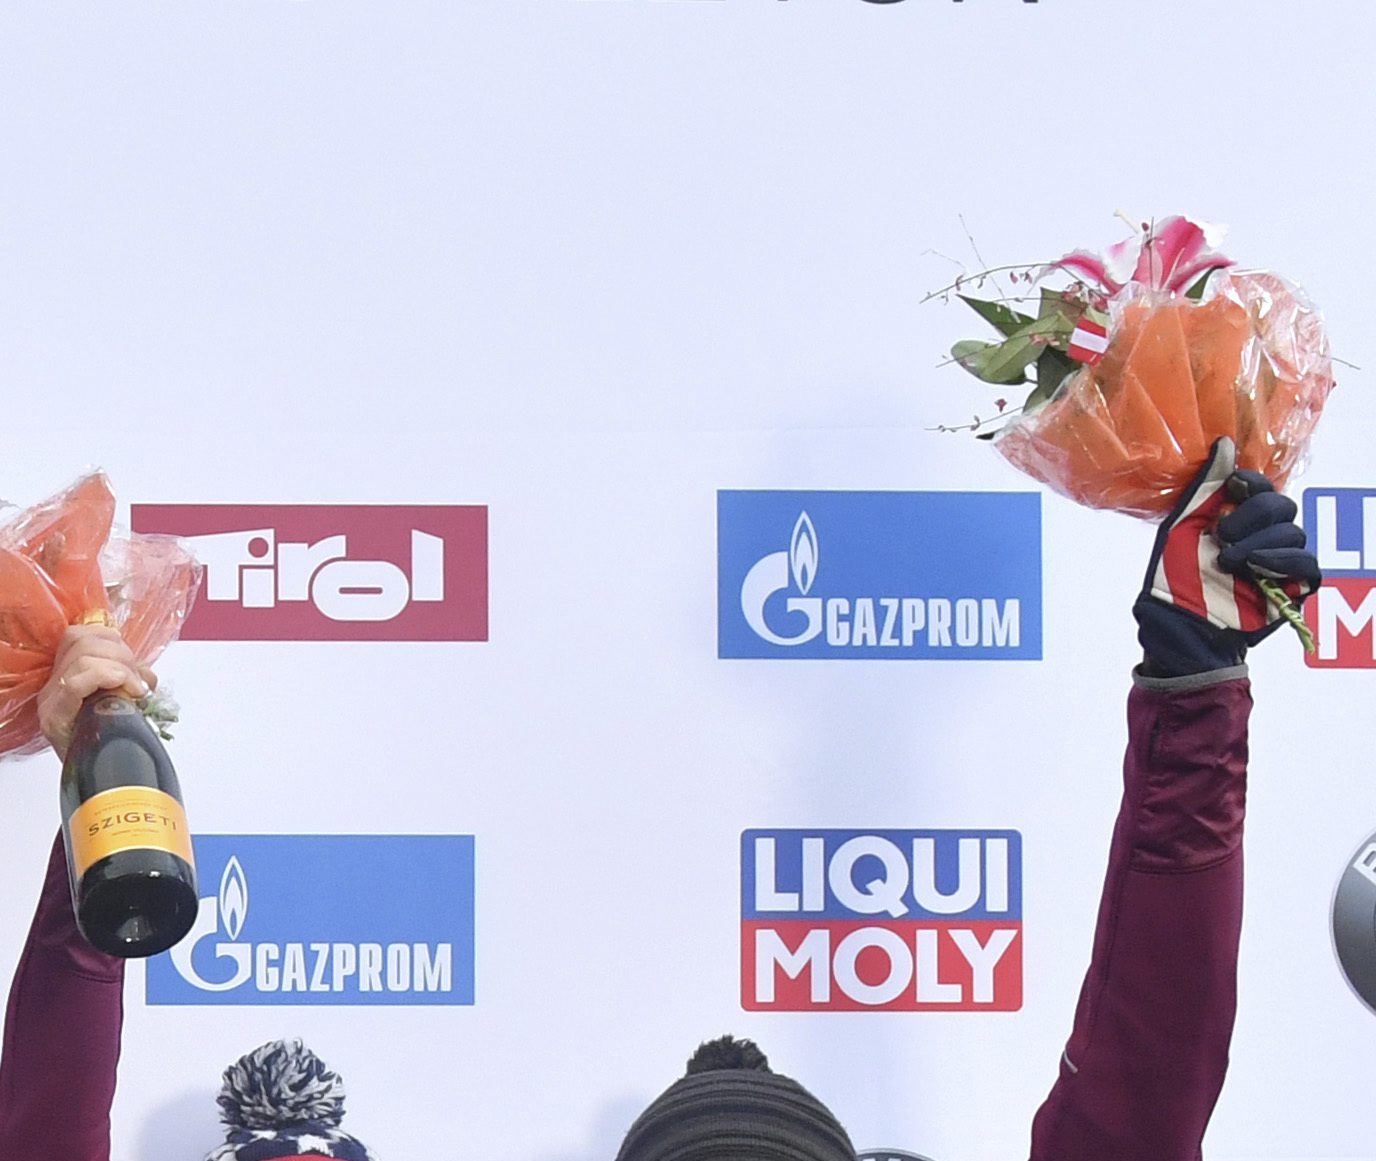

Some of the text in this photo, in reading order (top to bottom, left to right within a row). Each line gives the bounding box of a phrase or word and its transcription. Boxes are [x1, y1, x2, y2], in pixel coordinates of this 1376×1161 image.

[176, 528, 444, 622] Tirol
[826, 598, 1020, 648] GAZPROM
[88, 812, 177, 836] SZIGETI
[754, 836, 1009, 918] LIQUI
[254, 940, 453, 993] GAZPROM
[754, 926, 1019, 1005] MOLY
